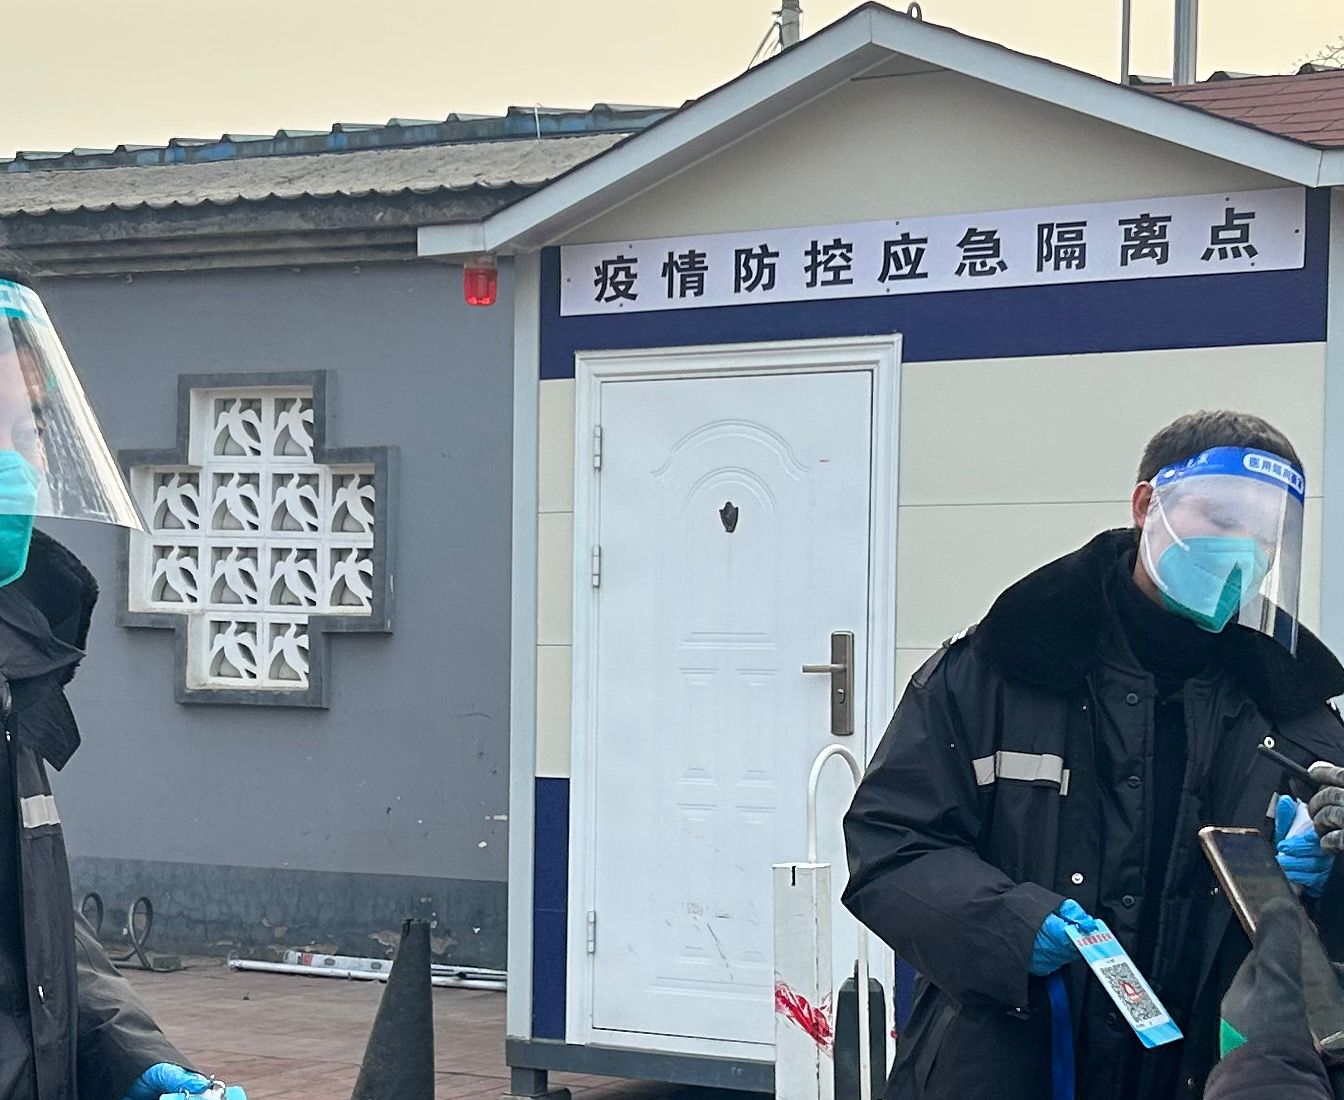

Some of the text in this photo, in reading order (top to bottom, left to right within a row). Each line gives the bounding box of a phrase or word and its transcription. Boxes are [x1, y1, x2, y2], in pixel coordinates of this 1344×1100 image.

[593, 206, 1259, 303] 疫情防控应急隔离点
